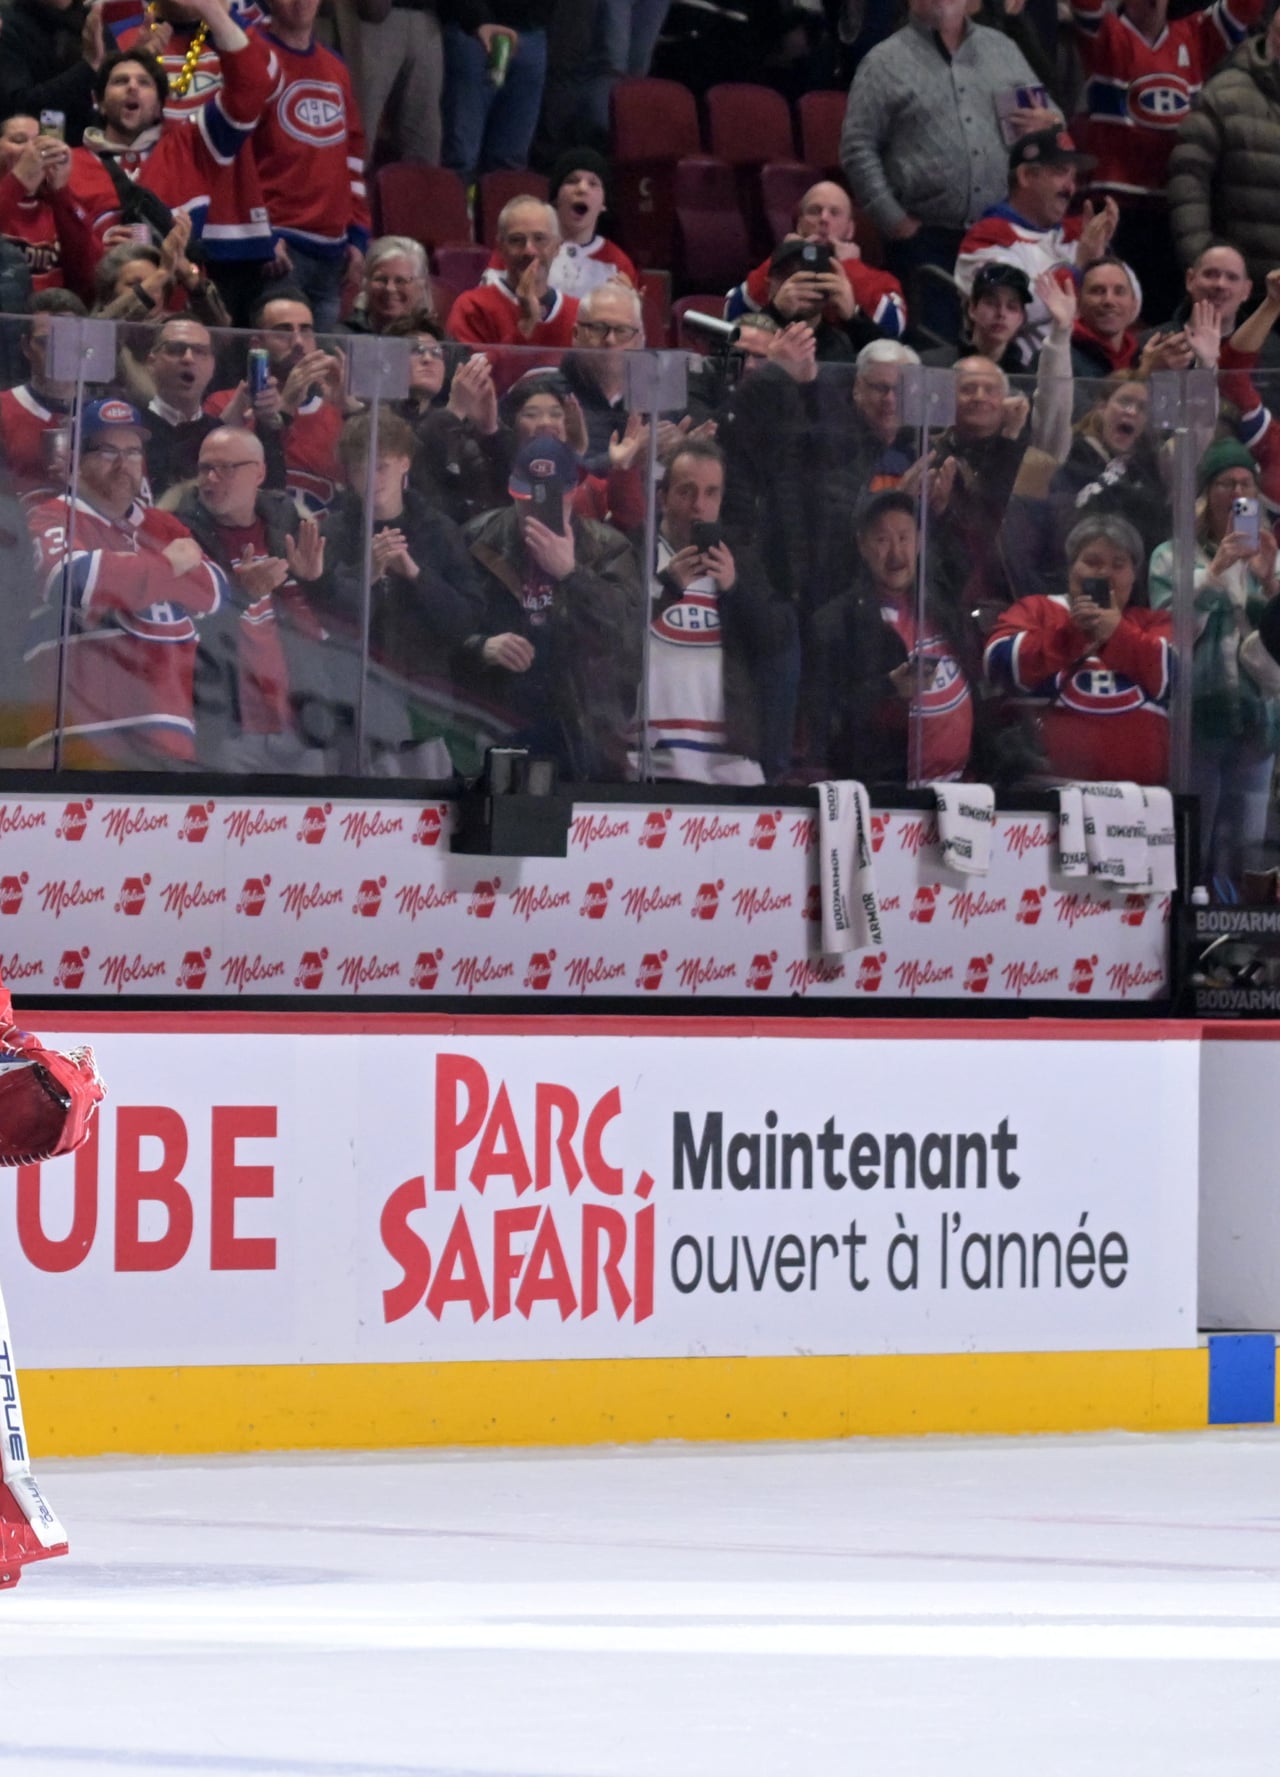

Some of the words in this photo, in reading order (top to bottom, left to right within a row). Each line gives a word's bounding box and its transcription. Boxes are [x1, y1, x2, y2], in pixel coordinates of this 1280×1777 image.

[102, 807, 168, 846] Molson
[224, 809, 287, 846] Molson
[340, 811, 402, 848] Molson
[571, 815, 629, 851] Molson
[680, 816, 740, 851] Molson
[38, 880, 104, 919] Molson
[160, 881, 226, 920] Molson
[280, 883, 343, 920] Molson
[395, 884, 456, 921] Molson
[509, 885, 570, 922] Molson
[622, 886, 682, 923] Molson
[732, 888, 792, 924] Molson
[949, 891, 1006, 928] Molson
[1055, 893, 1112, 929] Molson
[98, 953, 165, 993] Molson
[220, 954, 285, 993] Molson
[337, 955, 400, 993] Molson
[451, 956, 514, 994] Molson
[564, 957, 626, 995] Molson
[676, 957, 736, 995] Molson
[786, 959, 845, 995] Molson
[895, 958, 954, 997] Molson
[1002, 960, 1059, 997] Molson
[1106, 961, 1164, 998] Molson
[435, 1053, 622, 1198] PARC
[673, 1110, 1020, 1192] Maintenant
[670, 1219, 869, 1294] ouvert
[887, 1213, 919, 1293] à
[941, 1211, 1129, 1291] l'année
